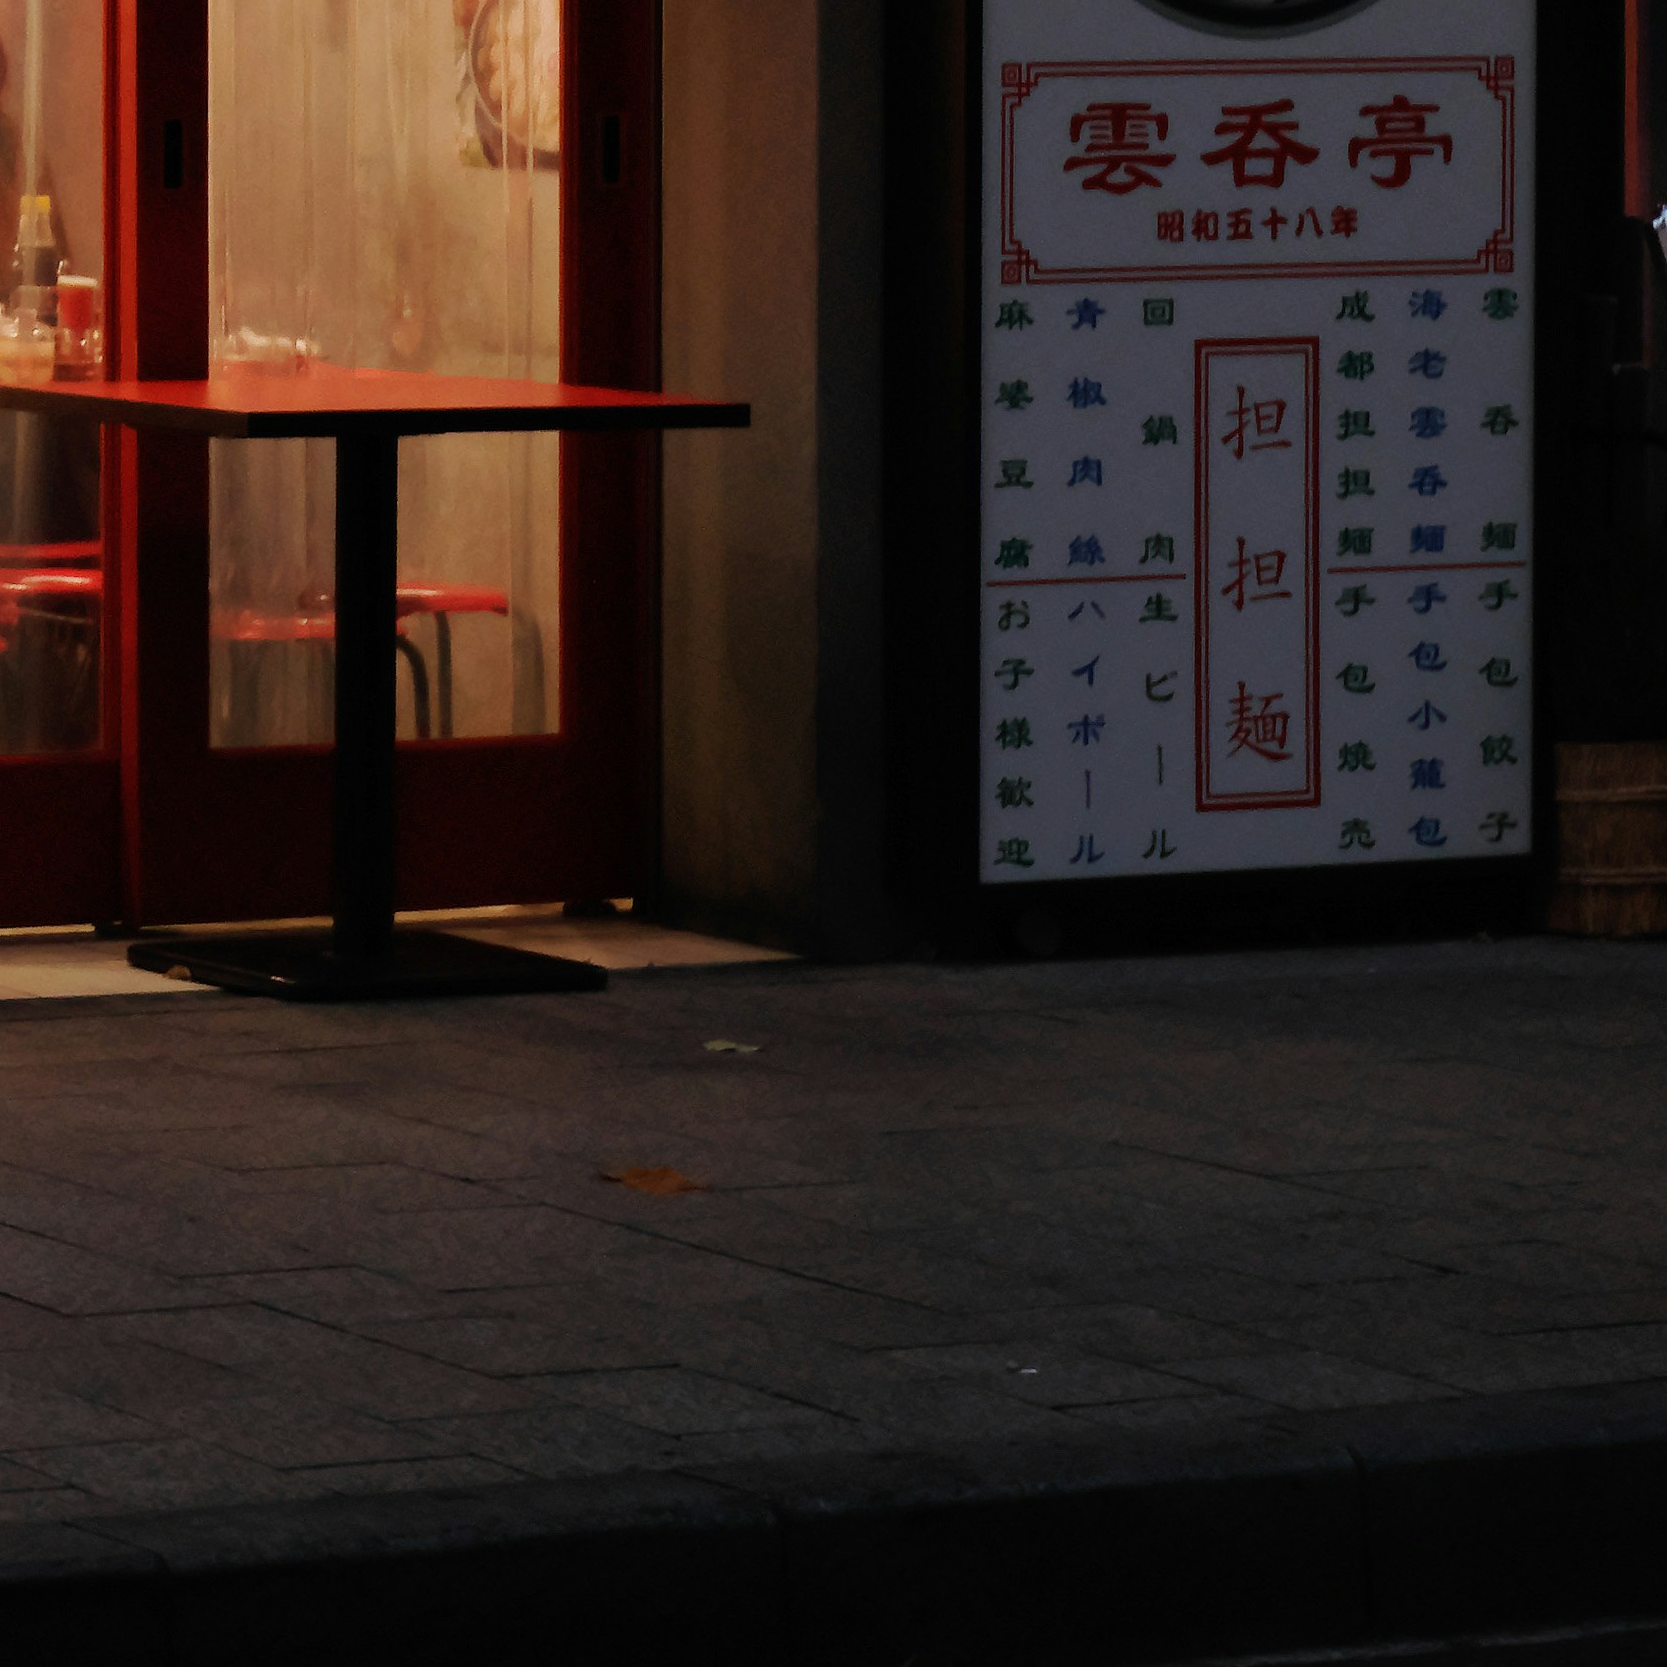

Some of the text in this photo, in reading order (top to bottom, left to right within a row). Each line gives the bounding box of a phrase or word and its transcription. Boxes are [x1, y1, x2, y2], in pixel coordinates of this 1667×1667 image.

[1063, 94, 1453, 196] 雲呑亭
[1157, 205, 1357, 243] 昭和五十八年
[1138, 297, 1179, 566] 回鍋肉
[993, 600, 1036, 869] お子様歓迎
[1066, 601, 1106, 866] ハイボール
[1138, 592, 1179, 861] 生ビール
[1478, 579, 1520, 844] 手包餃子
